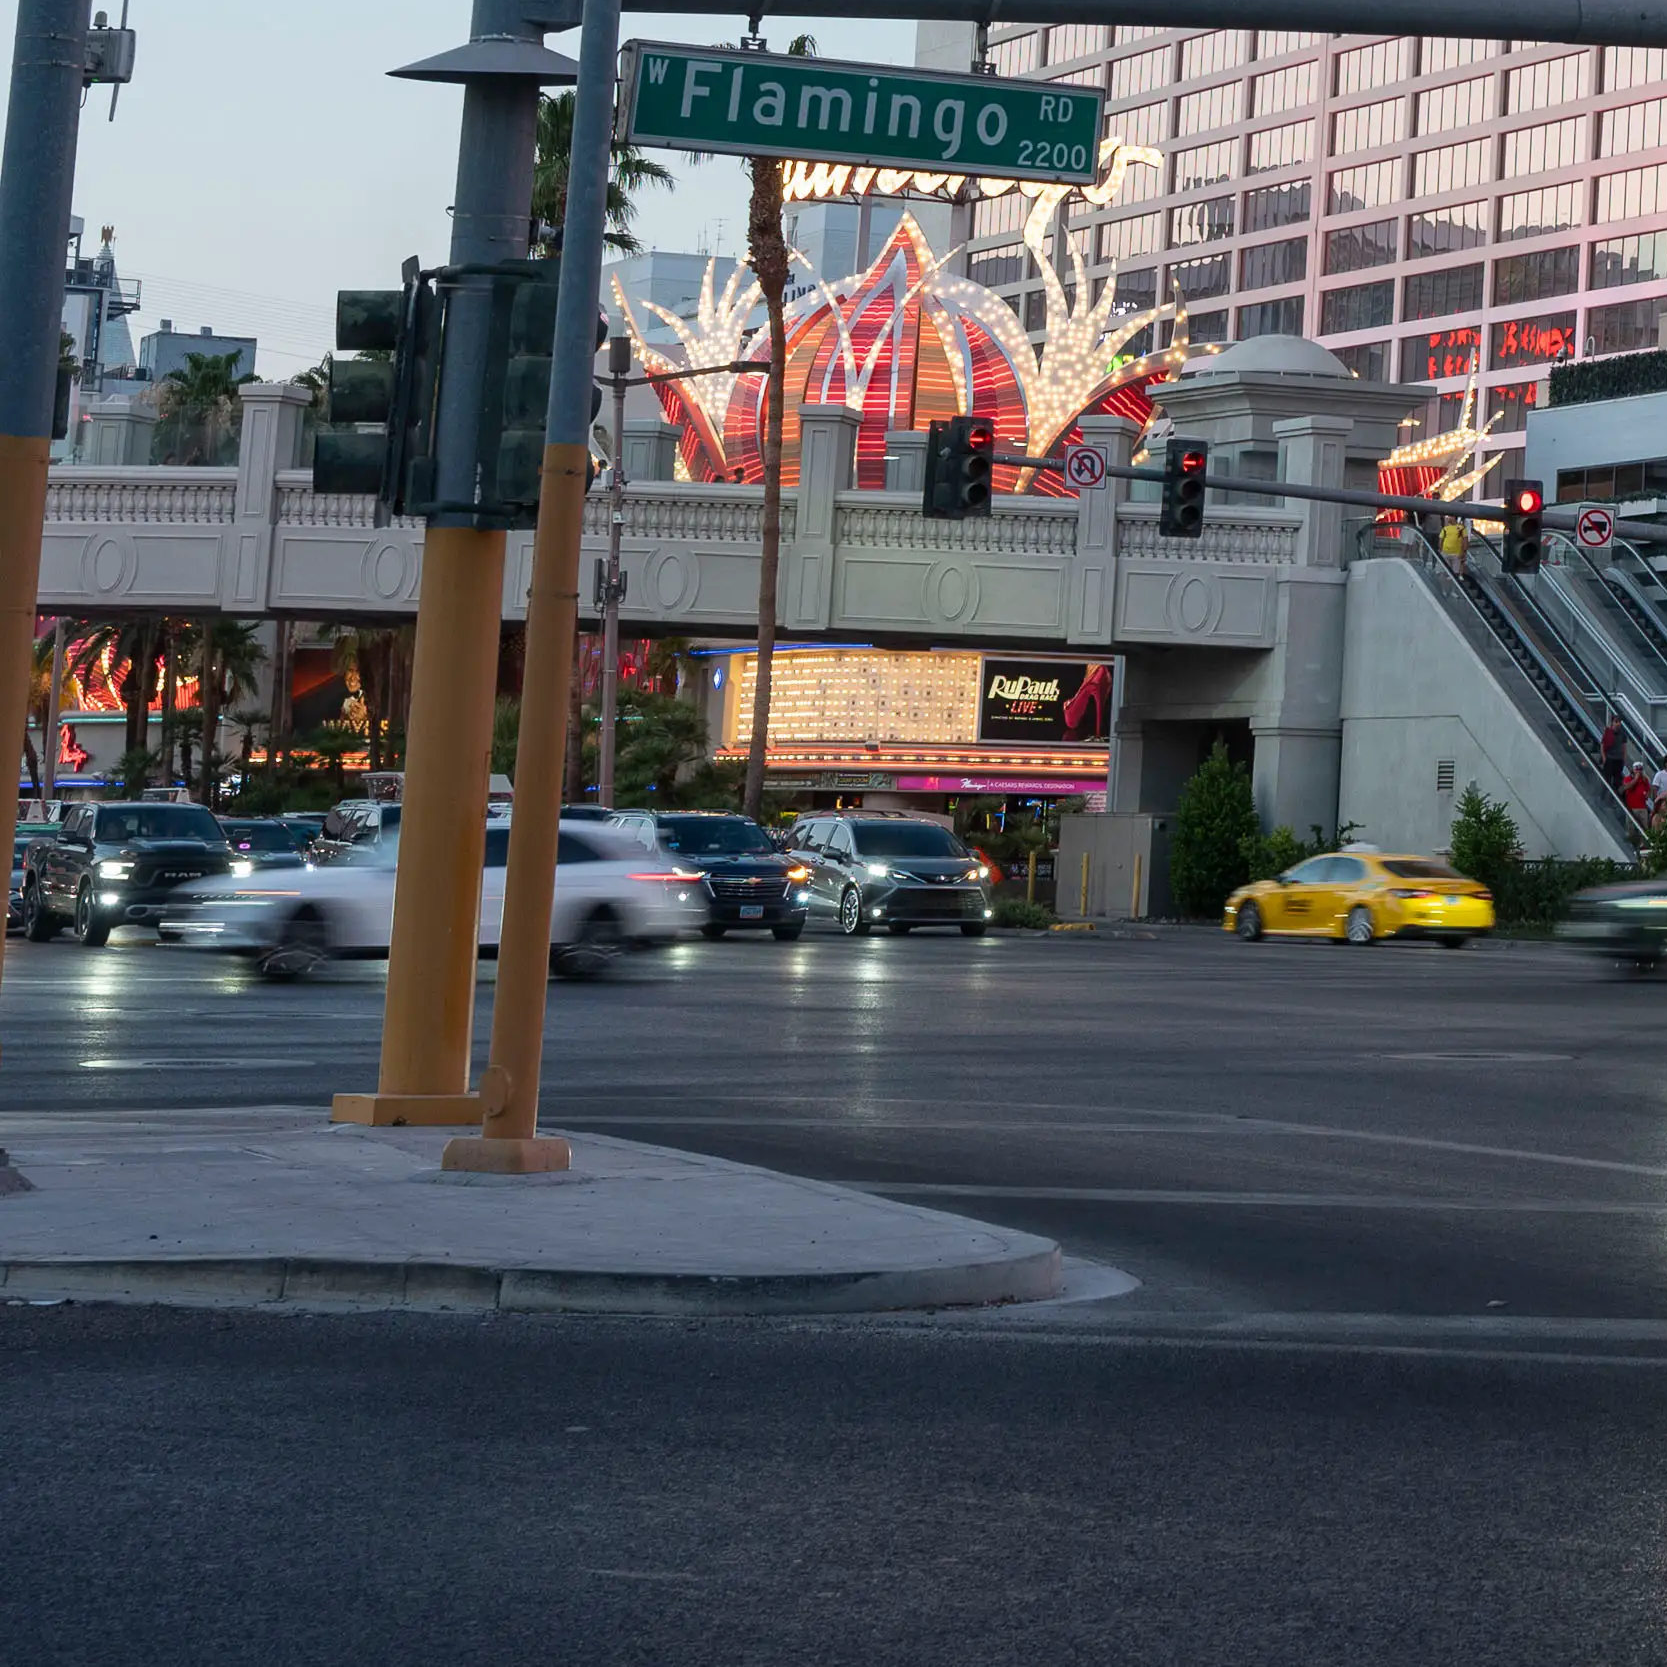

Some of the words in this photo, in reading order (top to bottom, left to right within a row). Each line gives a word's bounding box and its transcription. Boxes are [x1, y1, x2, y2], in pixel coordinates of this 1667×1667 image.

[648, 57, 668, 85] W
[679, 59, 1008, 160] Flamingo
[1040, 95, 1074, 123] RD
[1017, 140, 1087, 171] 2200
[1011, 701, 1038, 714] LIVE
